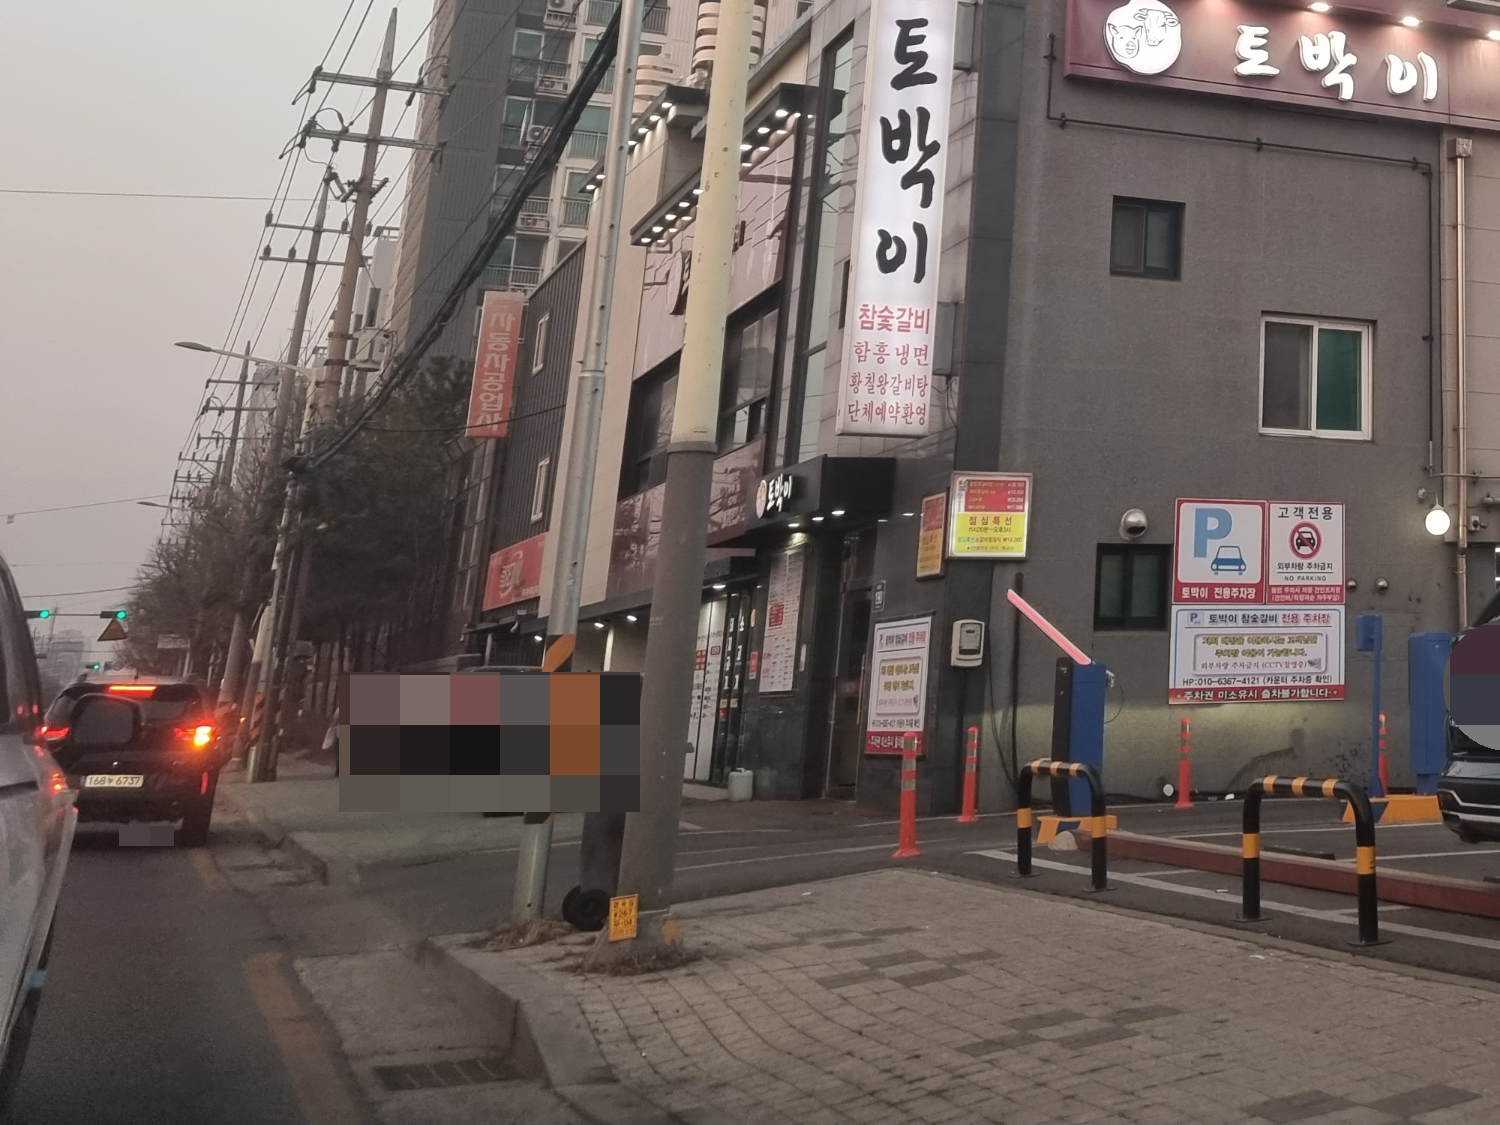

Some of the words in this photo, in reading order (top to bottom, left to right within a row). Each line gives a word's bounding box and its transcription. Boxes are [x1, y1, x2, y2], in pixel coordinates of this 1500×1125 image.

[1233, 24, 1438, 102] 토박이
[876, 17, 941, 285] 토박이
[859, 303, 931, 335] 참숯갈비
[854, 341, 929, 366] 함흥냉면
[474, 313, 517, 432] 자동차공업사
[850, 372, 928, 397] 황칠왕갈비탕
[848, 400, 926, 426] 단체예약환영
[766, 473, 792, 513] 토박이
[1277, 506, 1334, 521] 고객전용
[1193, 508, 1232, 558] P
[1277, 562, 1304, 571] 외부차량
[1306, 562, 1333, 571] 주차금지
[1181, 586, 1208, 599] 토박이
[1213, 586, 1256, 599] 전용주차장
[1209, 613, 1237, 624] 토박이
[1241, 613, 1278, 624] 참숯갈비
[1281, 613, 1300, 624] 전용
[1303, 613, 1331, 624] 주차장
[1231, 661, 1259, 670] 주차금지
[1182, 676, 1260, 686] HP:010-6367-4121
[1183, 691, 1214, 701] 주차권
[1217, 690, 1258, 700] 미소유시
